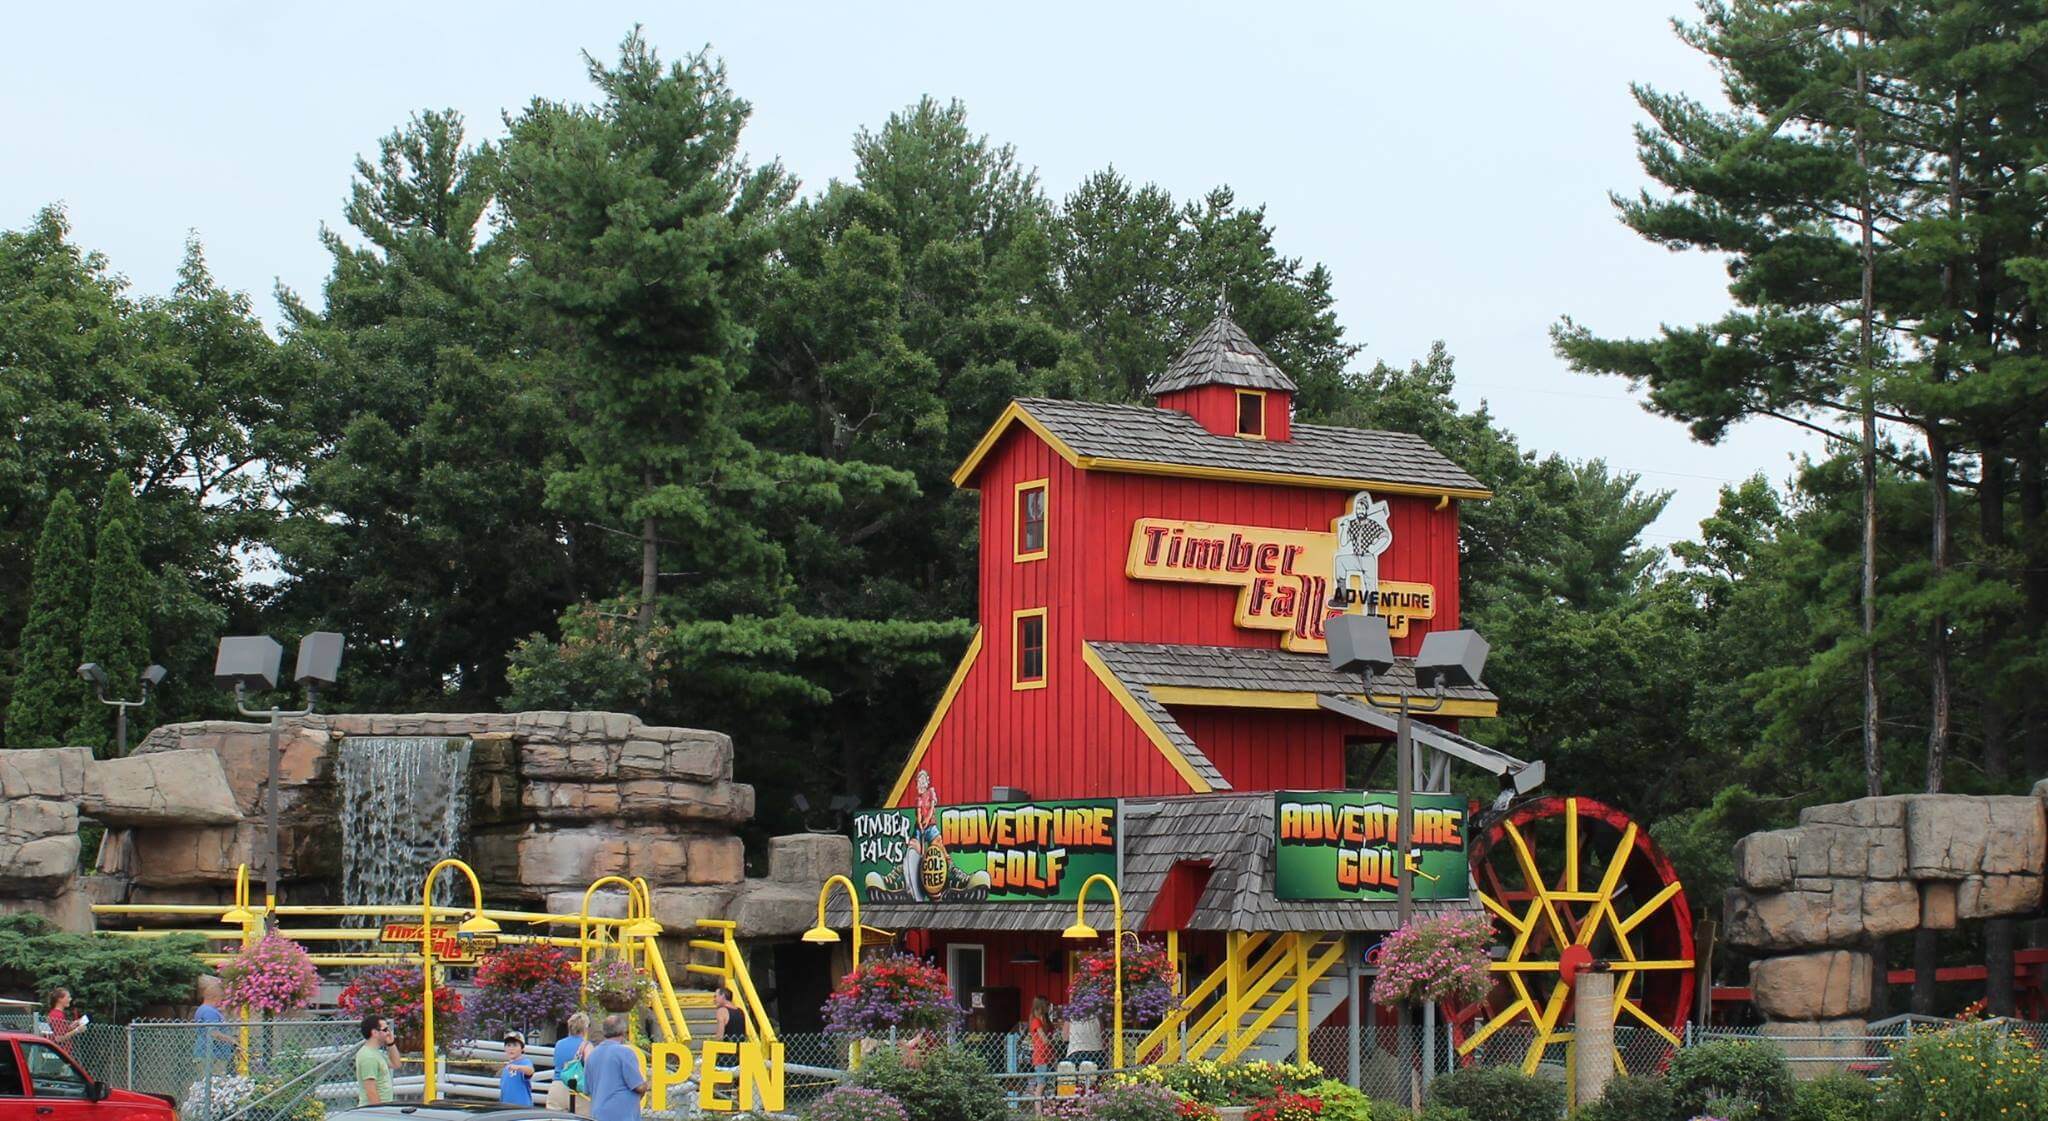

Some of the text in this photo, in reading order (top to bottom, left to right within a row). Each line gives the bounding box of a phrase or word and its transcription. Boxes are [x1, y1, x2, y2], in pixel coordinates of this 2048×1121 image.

[1144, 526, 1303, 576] Timber
[1249, 574, 1344, 640] Fall
[1333, 586, 1430, 609] ADVENTURE
[1367, 613, 1405, 630] LF
[854, 811, 910, 845] TIMBER
[941, 805, 1113, 847] ADVENTURE
[859, 837, 904, 864] FALLS
[922, 858, 944, 872] GOLF
[922, 871, 944, 887] FREE
[986, 847, 1066, 889] GOLF
[428, 937, 462, 958] alls
[625, 1040, 785, 1112] PEN
